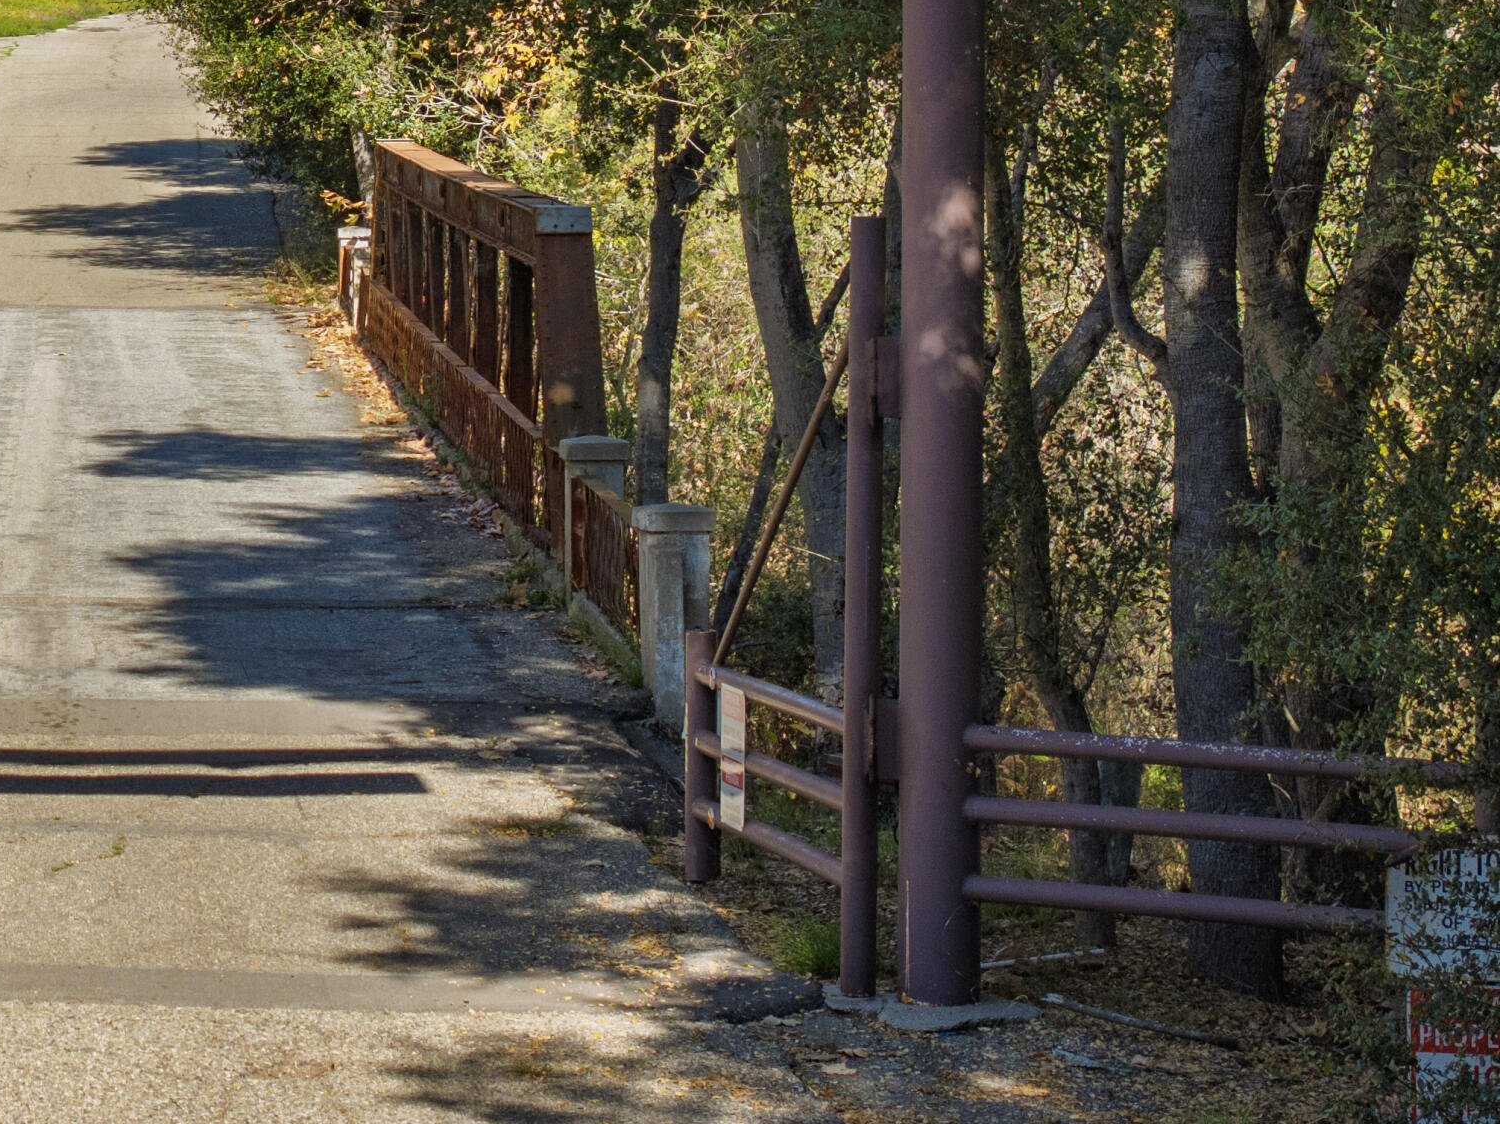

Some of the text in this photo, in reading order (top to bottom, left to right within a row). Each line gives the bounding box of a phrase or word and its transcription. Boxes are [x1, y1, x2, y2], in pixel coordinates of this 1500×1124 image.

[1404, 850, 1464, 875] RGHT
[1404, 880, 1423, 892] BY
[1442, 915, 1462, 929] OF
